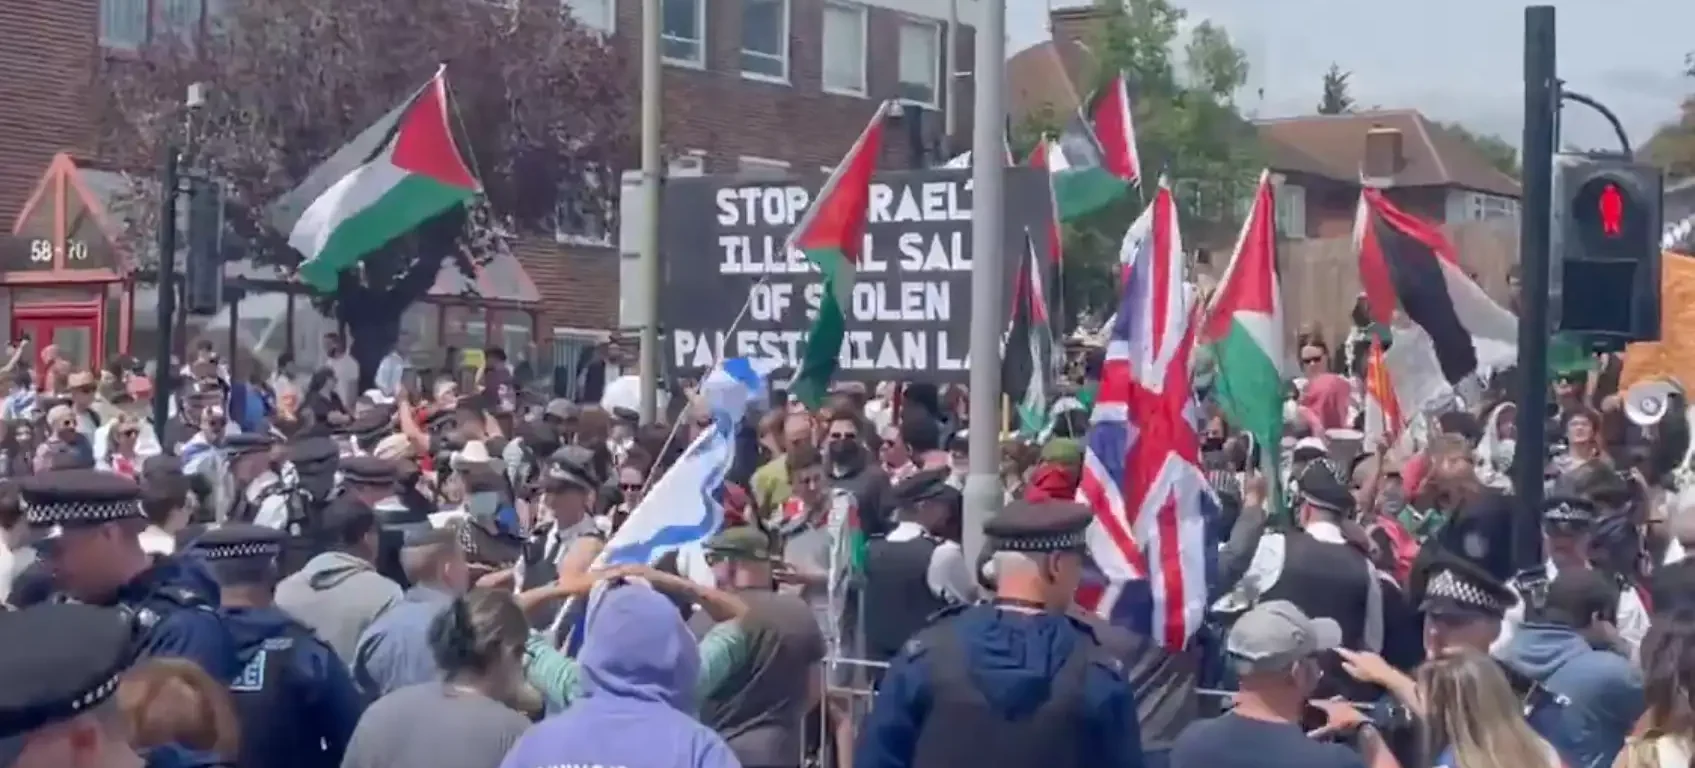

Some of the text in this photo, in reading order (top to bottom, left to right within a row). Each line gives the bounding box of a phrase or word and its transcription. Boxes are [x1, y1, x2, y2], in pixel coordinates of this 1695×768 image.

[716, 186, 808, 226] STOP
[31, 239, 52, 261] 58
[68, 239, 88, 260] 70
[898, 231, 973, 271] SAL
[750, 281, 949, 321] OF SOLEN
